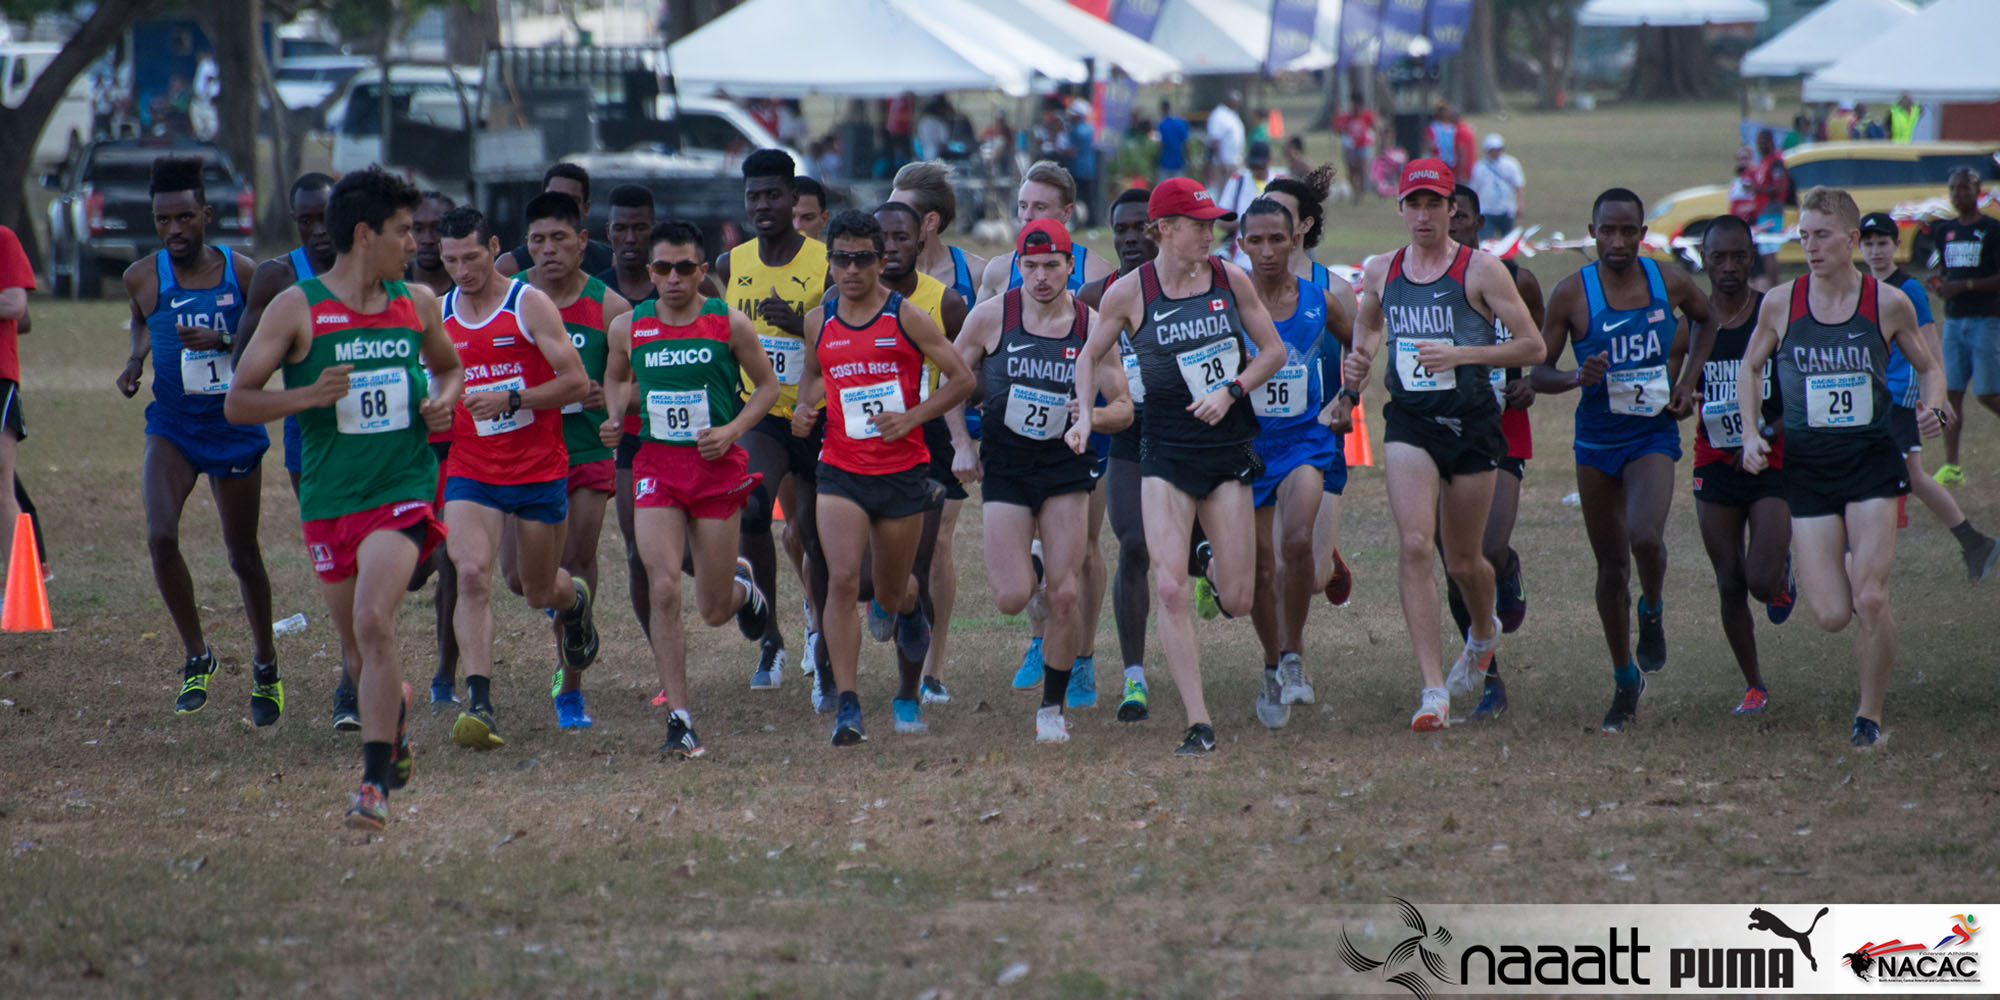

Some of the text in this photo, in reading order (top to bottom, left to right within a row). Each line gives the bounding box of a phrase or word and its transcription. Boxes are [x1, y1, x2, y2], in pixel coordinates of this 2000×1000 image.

[177, 312, 229, 334] USA
[1157, 314, 1231, 345] CANADA
[1389, 305, 1454, 334] CANADA
[335, 338, 411, 361] MÉXICO
[645, 347, 712, 368] MÉXICO
[1611, 330, 1661, 364] USA
[829, 362, 898, 379] COSTA RICA
[1007, 357, 1076, 383] CANADA
[1793, 347, 1874, 372] CANADA
[207, 360, 220, 383] 1
[464, 361, 523, 382] STA RICA
[1201, 357, 1225, 386] 28
[203, 384, 229, 392] UCS
[1267, 382, 1289, 405] 56
[1633, 384, 1645, 404] 2
[360, 389, 387, 419] 68
[1828, 390, 1853, 415] 29
[360, 419, 390, 429] UCS
[491, 420, 517, 431] UCS
[667, 407, 690, 429] 69
[1024, 403, 1050, 428] 25
[1721, 413, 1743, 435] 98
[1827, 416, 1855, 424] UCS
[1021, 426, 1046, 436] UCS
